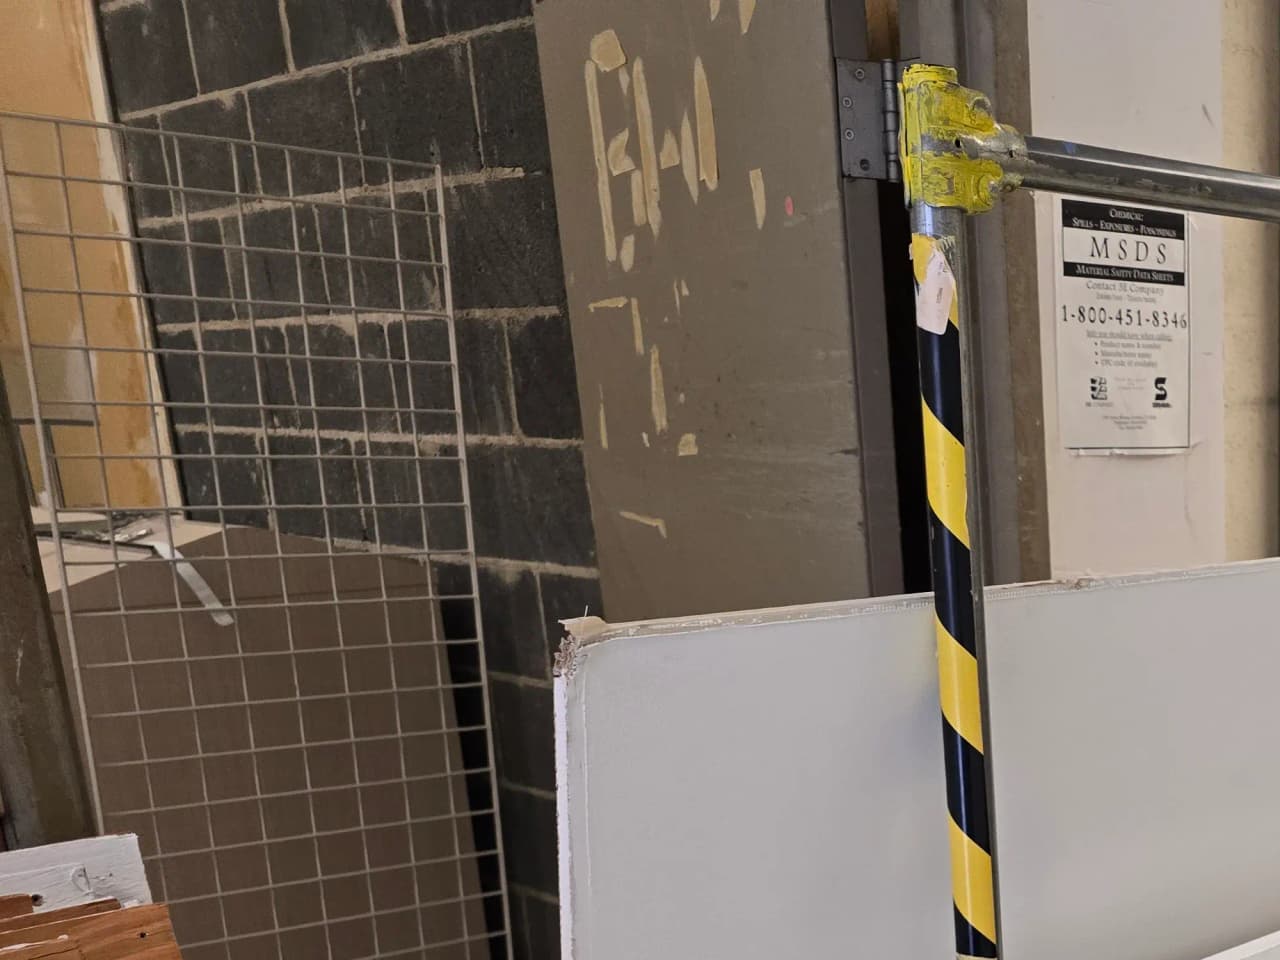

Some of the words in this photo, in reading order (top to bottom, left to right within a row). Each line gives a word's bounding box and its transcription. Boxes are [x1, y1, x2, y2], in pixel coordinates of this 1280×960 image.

[1075, 264, 1109, 276] MATERIAL
[1110, 267, 1132, 279] SAFETY
[1133, 269, 1151, 280] DATA
[1151, 271, 1174, 281] SHEETS
[1062, 304, 1188, 329] 1-800-451-8346
